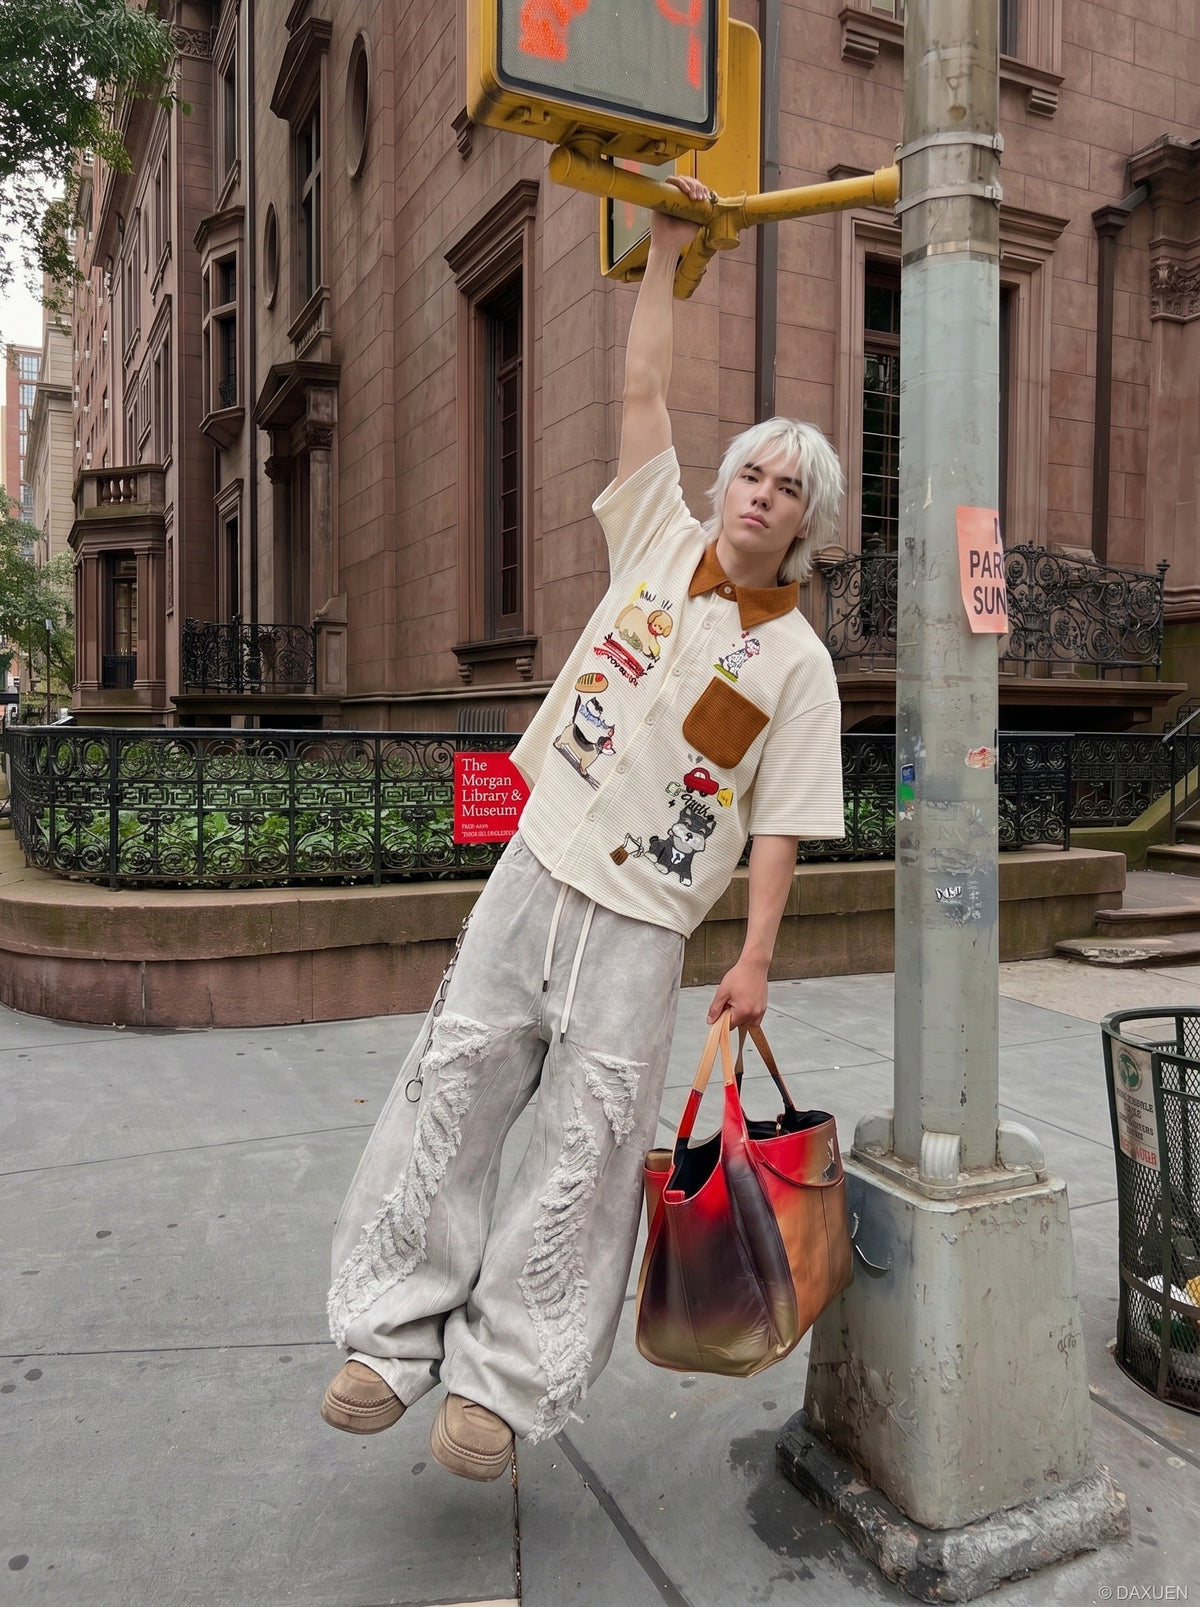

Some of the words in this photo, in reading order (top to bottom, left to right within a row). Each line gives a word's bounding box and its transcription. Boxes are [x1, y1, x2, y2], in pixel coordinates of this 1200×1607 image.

[973, 585, 1007, 615] SUN
[461, 758, 488, 771] The
[461, 773, 512, 790] Morgan
[461, 789, 508, 805] Library
[511, 789, 522, 801] &
[461, 804, 517, 817] Museum
